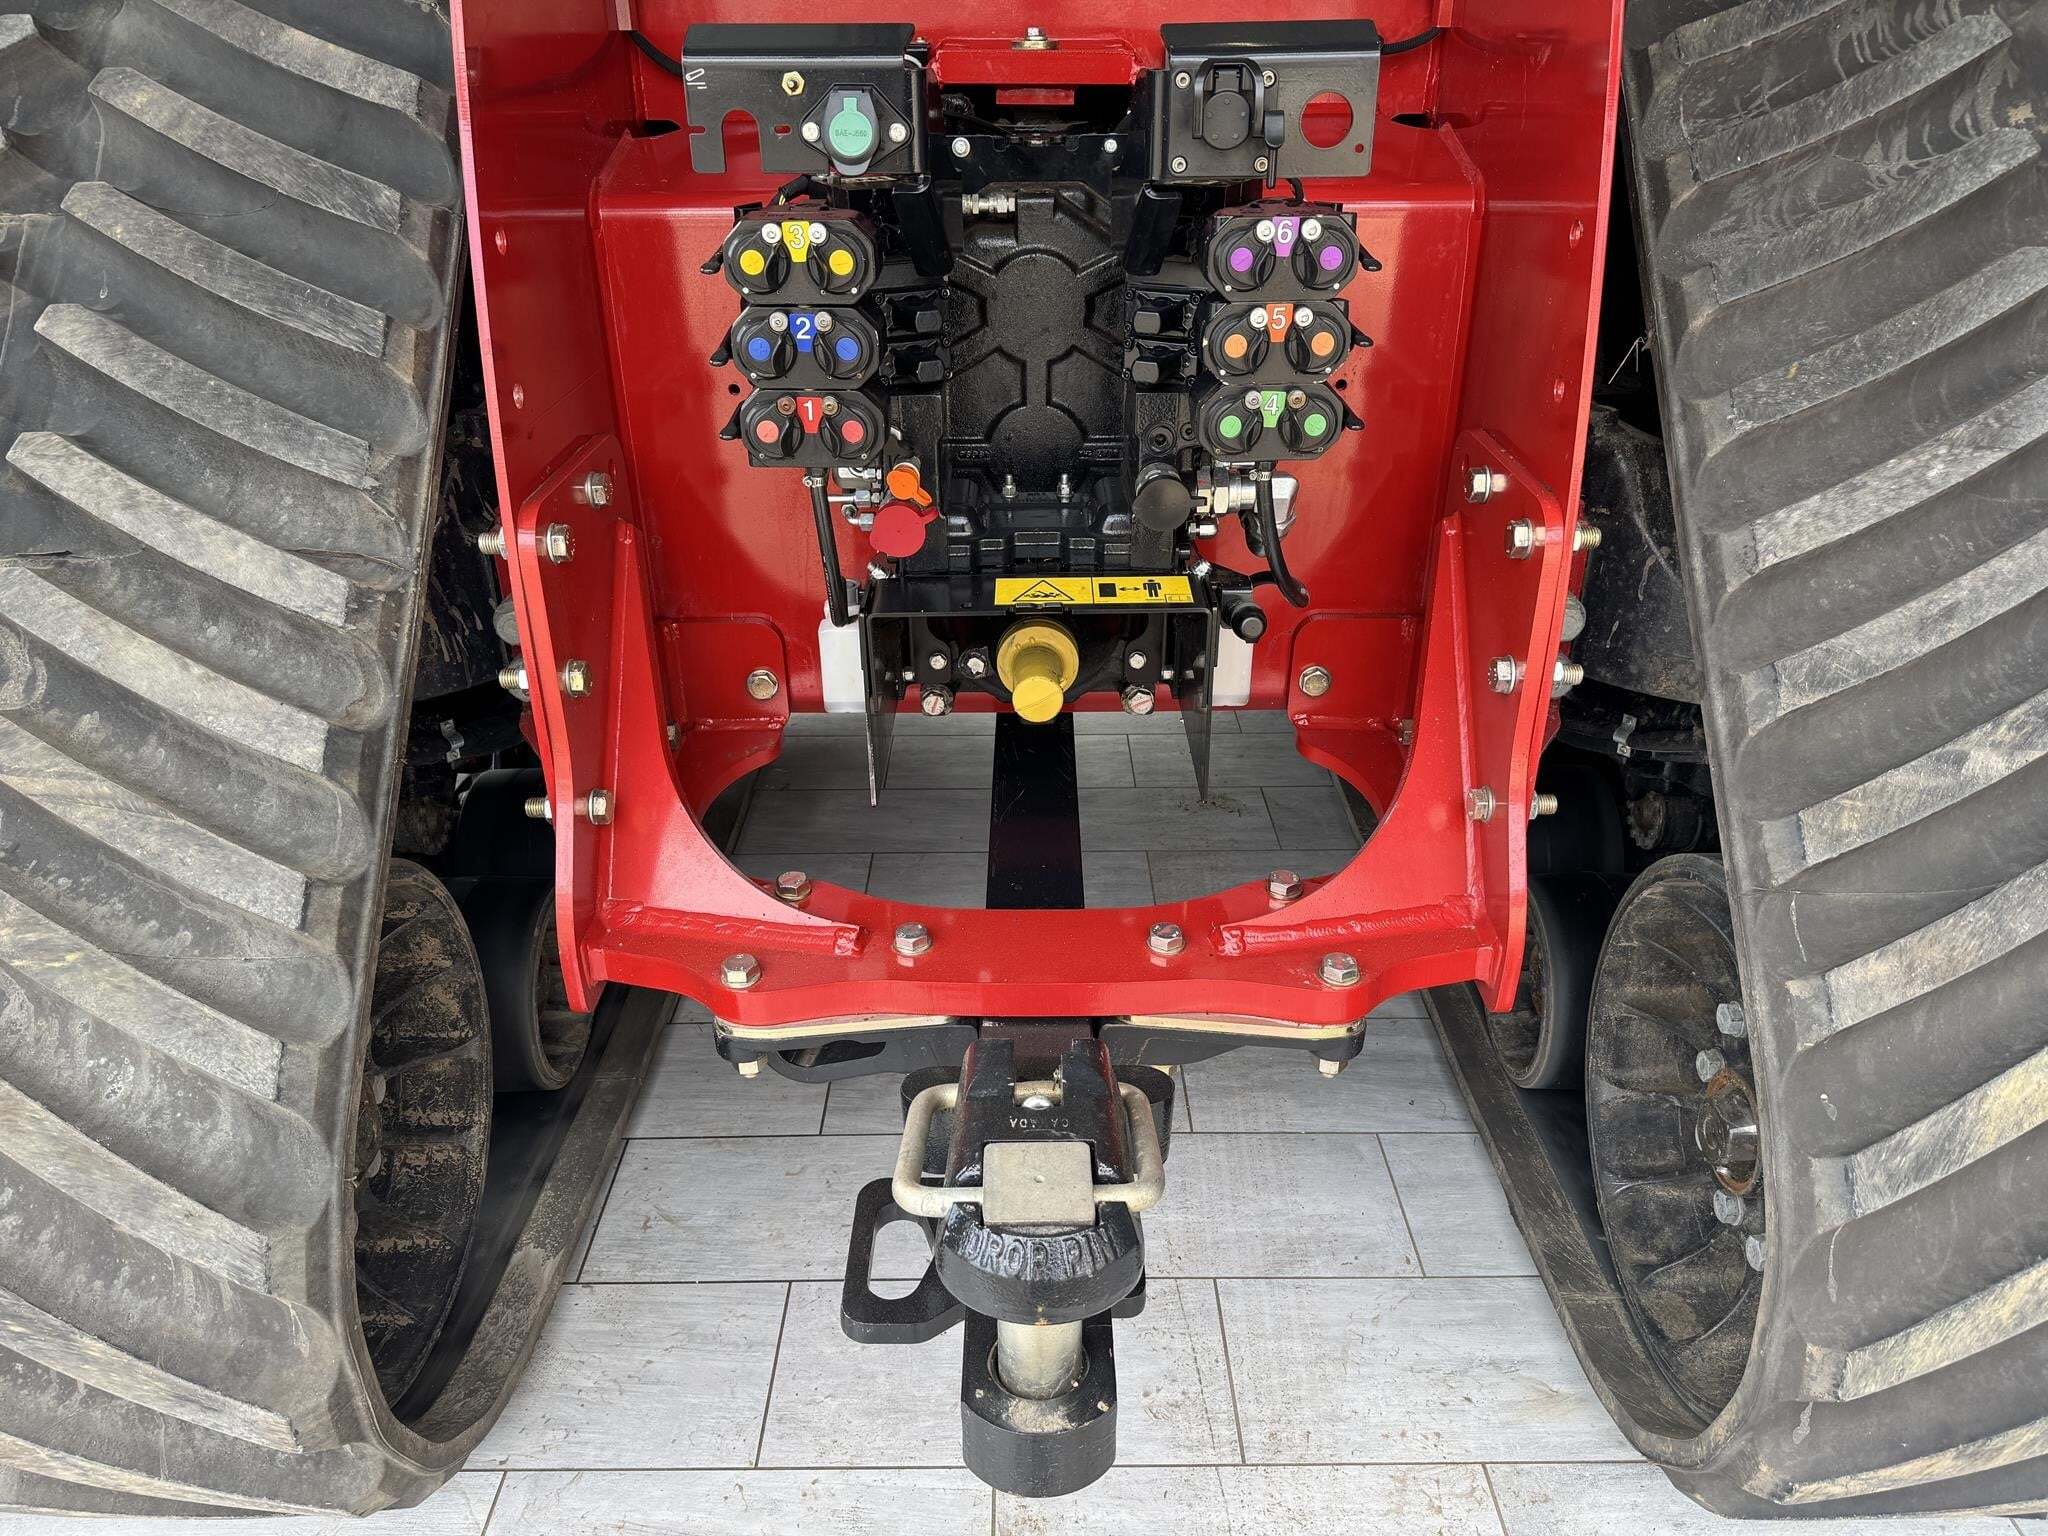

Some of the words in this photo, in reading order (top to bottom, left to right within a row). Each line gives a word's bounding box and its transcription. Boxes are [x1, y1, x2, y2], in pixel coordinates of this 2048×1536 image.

[789, 224, 804, 248] 3
[1277, 220, 1293, 244] 6
[795, 316, 811, 340] 2
[1271, 306, 1287, 330] 5
[803, 400, 813, 421] 1
[1263, 393, 1280, 415] 4
[960, 1227, 1049, 1280] DROP
[1061, 1229, 1121, 1279] PIN
